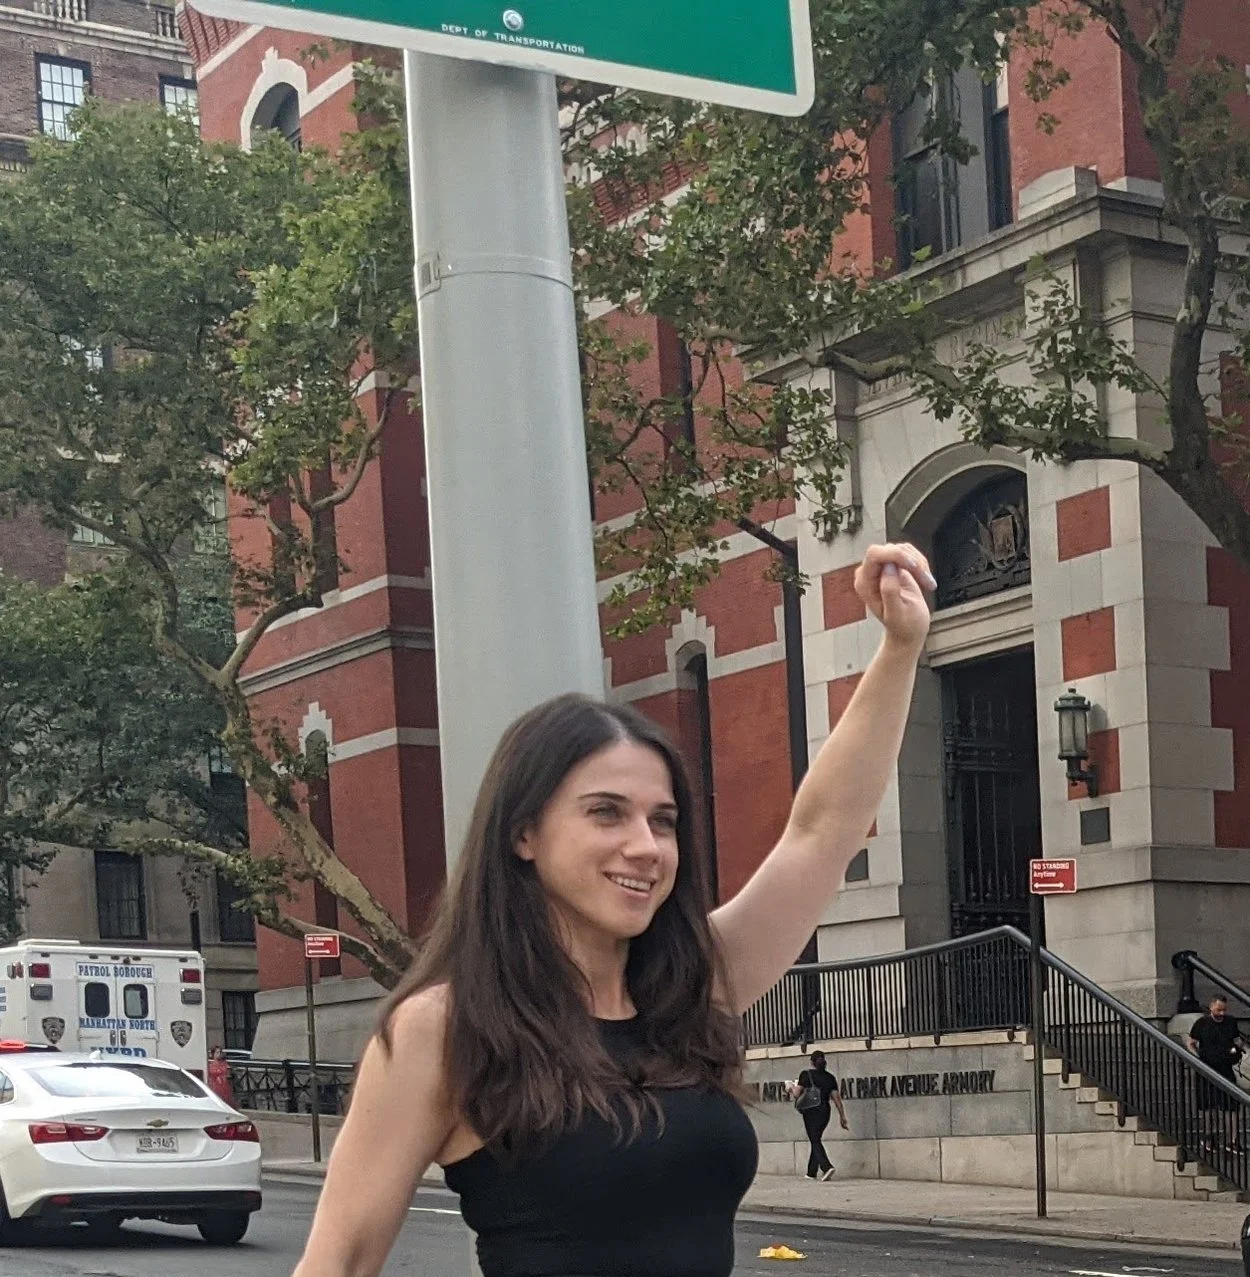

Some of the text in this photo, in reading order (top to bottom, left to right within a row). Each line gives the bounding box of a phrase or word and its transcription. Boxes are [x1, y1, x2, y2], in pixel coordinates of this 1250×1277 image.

[441, 23, 585, 54] DEPT OF TRANSPORTATION
[78, 965, 153, 978] PATROL BOROUGH
[79, 1017, 156, 1031] MANHATTAN NORTH
[840, 1077, 854, 1099] AT
[856, 1075, 888, 1099] PARK
[890, 1073, 940, 1097] AVENUE
[942, 1070, 996, 1095] ARMORY
